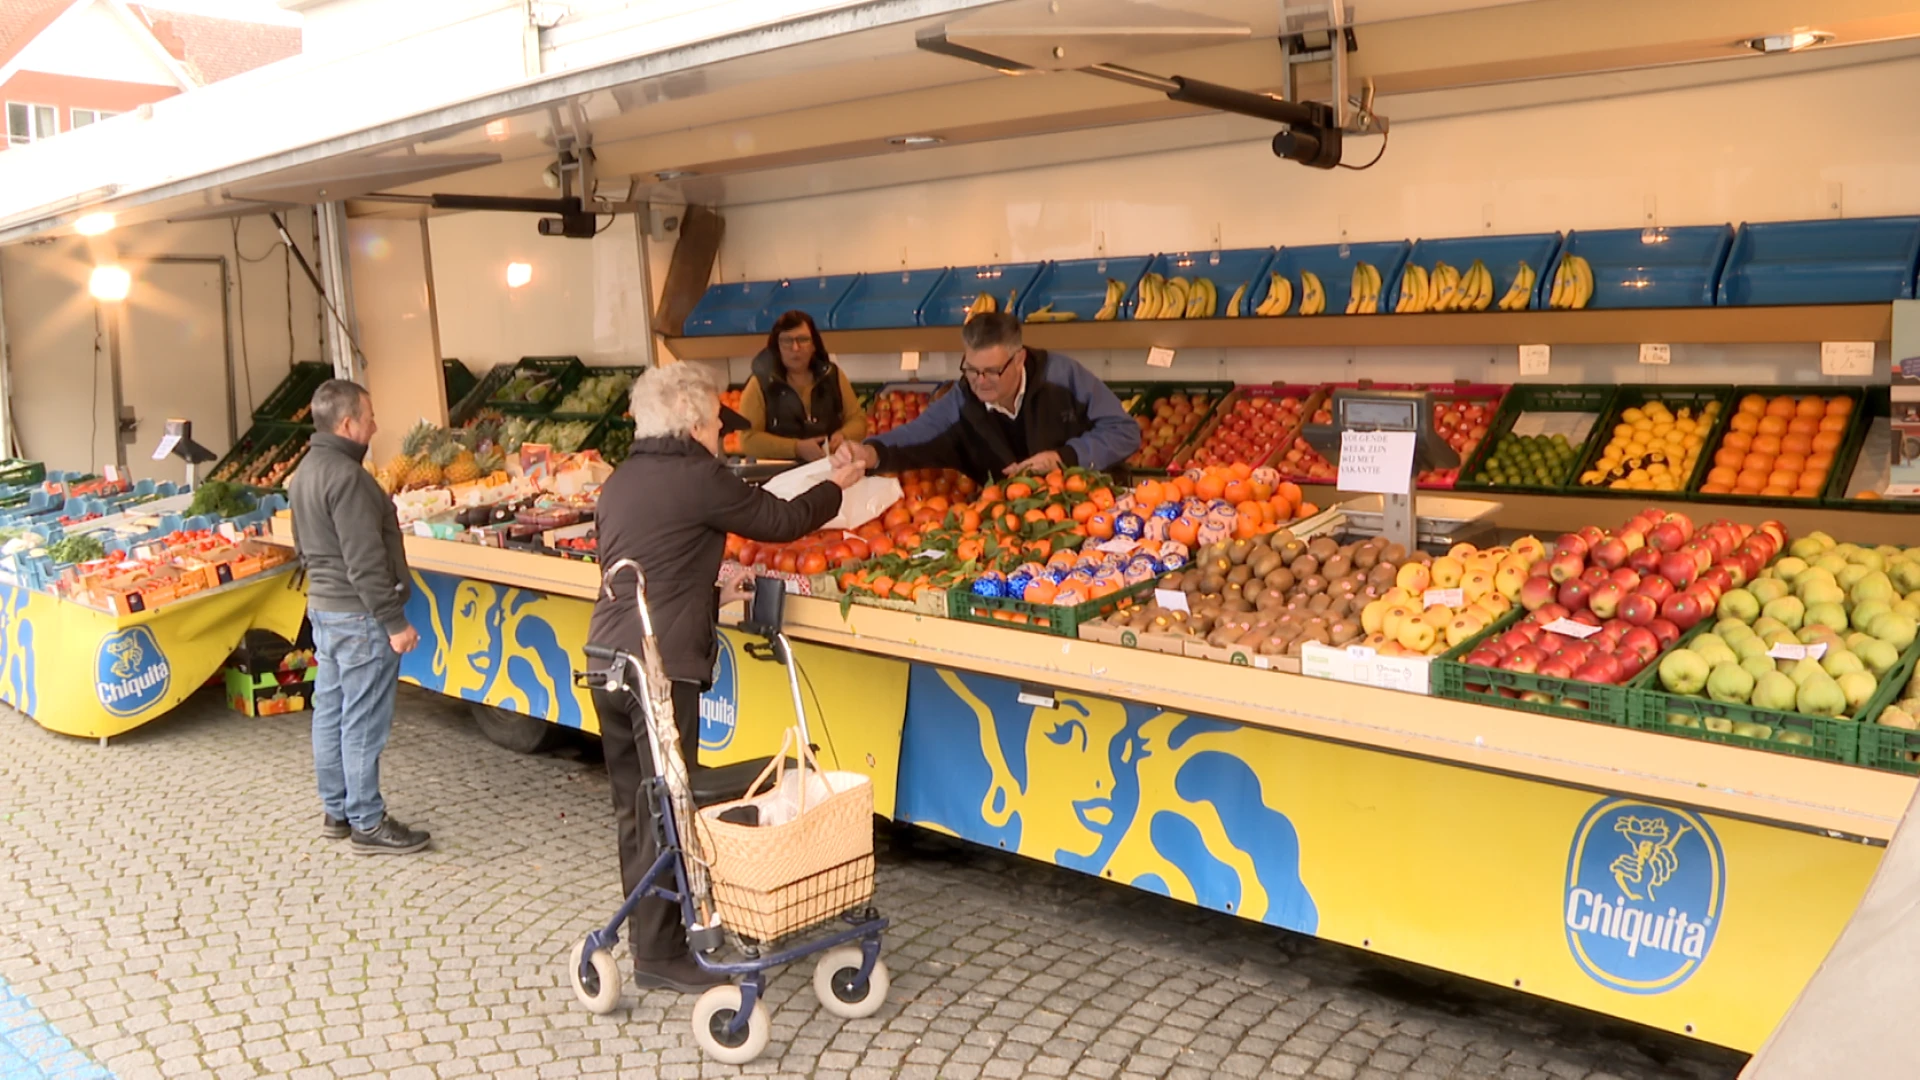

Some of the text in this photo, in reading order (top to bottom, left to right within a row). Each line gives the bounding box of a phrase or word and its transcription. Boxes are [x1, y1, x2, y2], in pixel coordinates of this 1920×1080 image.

[1343, 434, 1389, 443] VOLGENDE
[1343, 445, 1366, 453] WEEK
[1340, 465, 1381, 474] VAKANTIE
[97, 662, 169, 704] Chiquita
[699, 692, 735, 729] iquita
[1566, 888, 1707, 959] Chiquita
